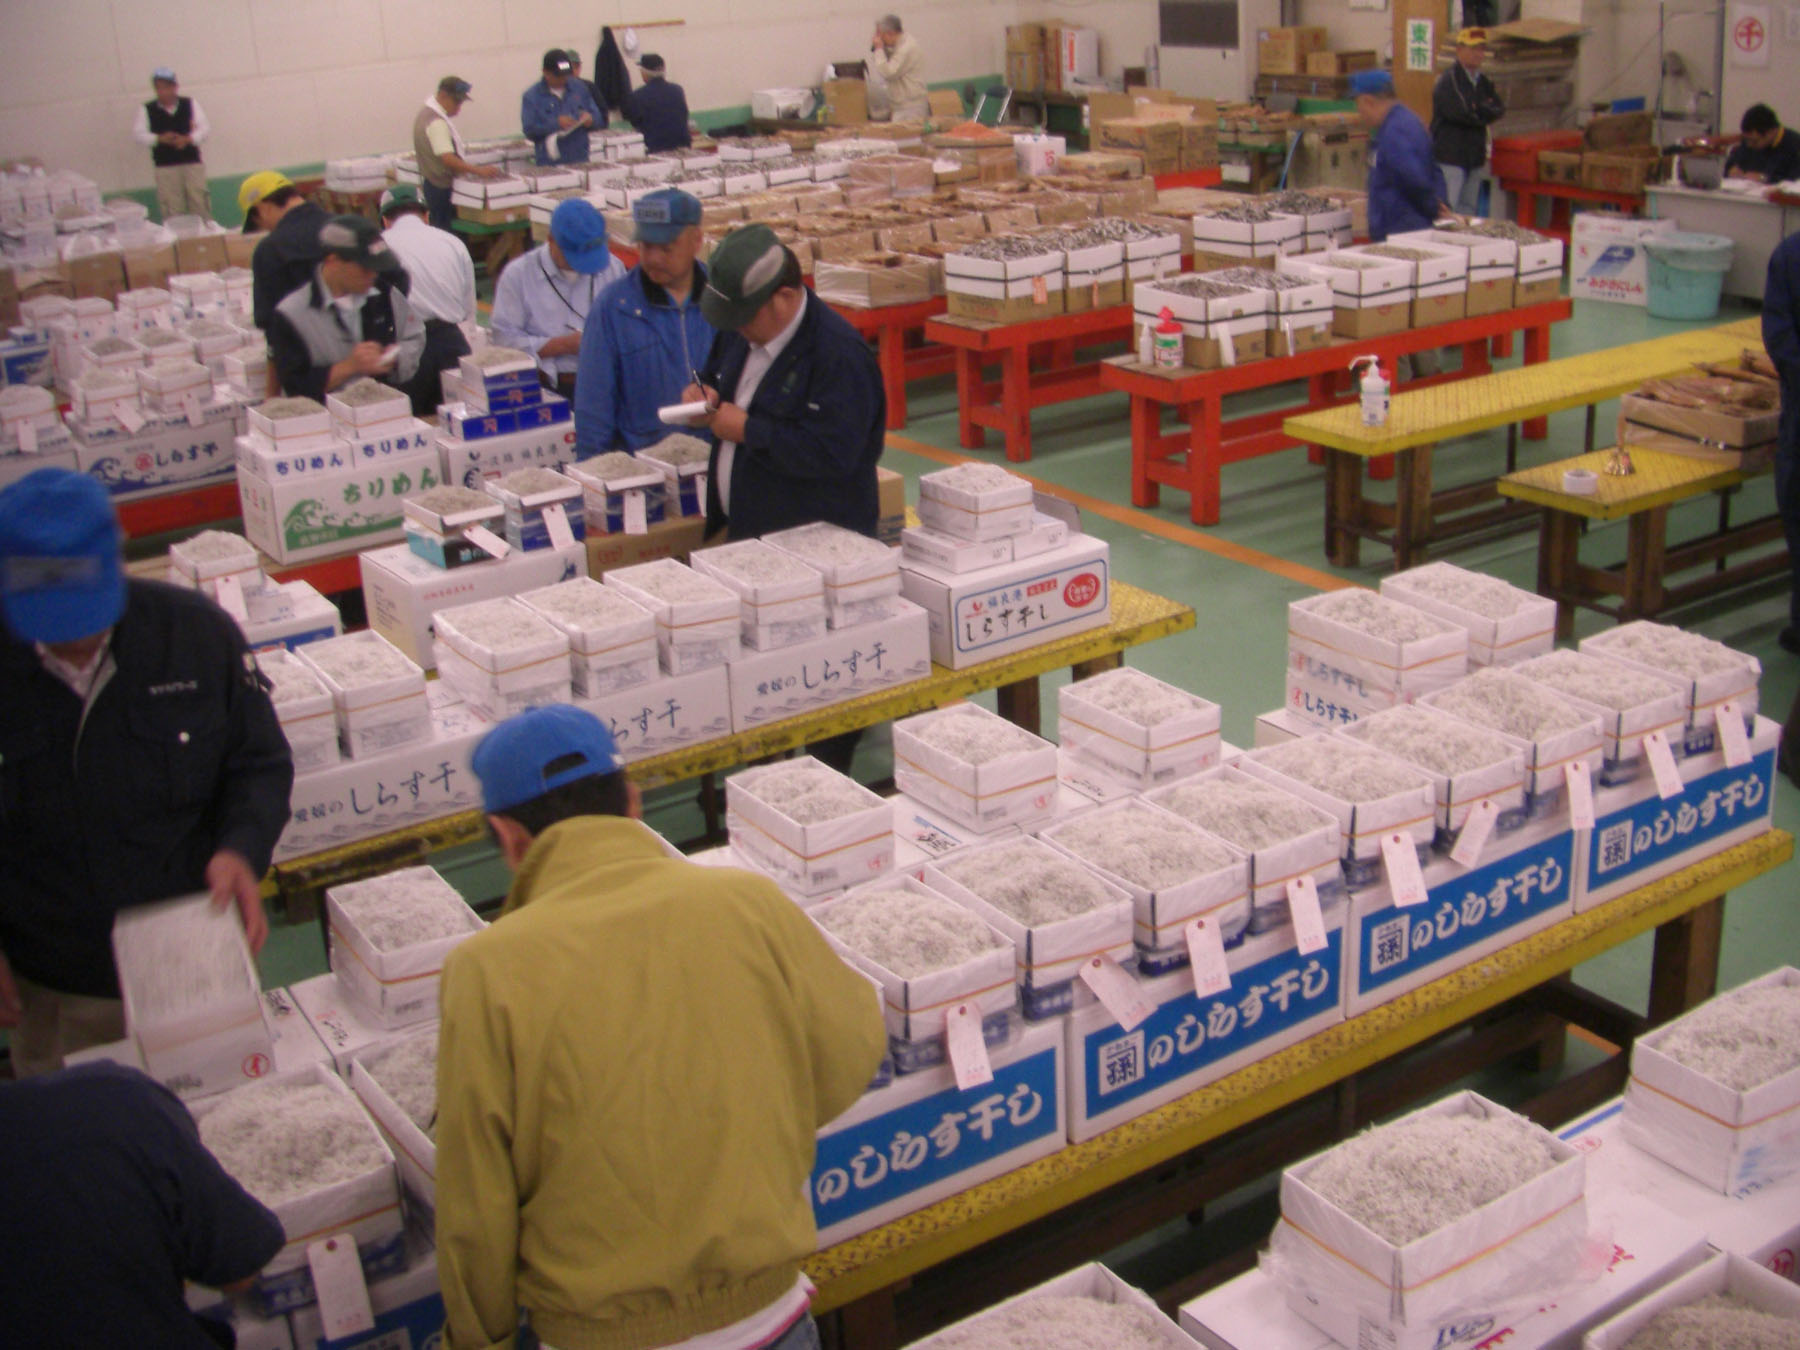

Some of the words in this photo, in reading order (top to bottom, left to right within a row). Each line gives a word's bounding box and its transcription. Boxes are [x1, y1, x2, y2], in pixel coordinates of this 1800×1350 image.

[363, 434, 427, 457] ちりめん
[276, 453, 343, 476] ちりめん
[343, 467, 438, 504] ちりめん
[965, 603, 1048, 643] しらす干し
